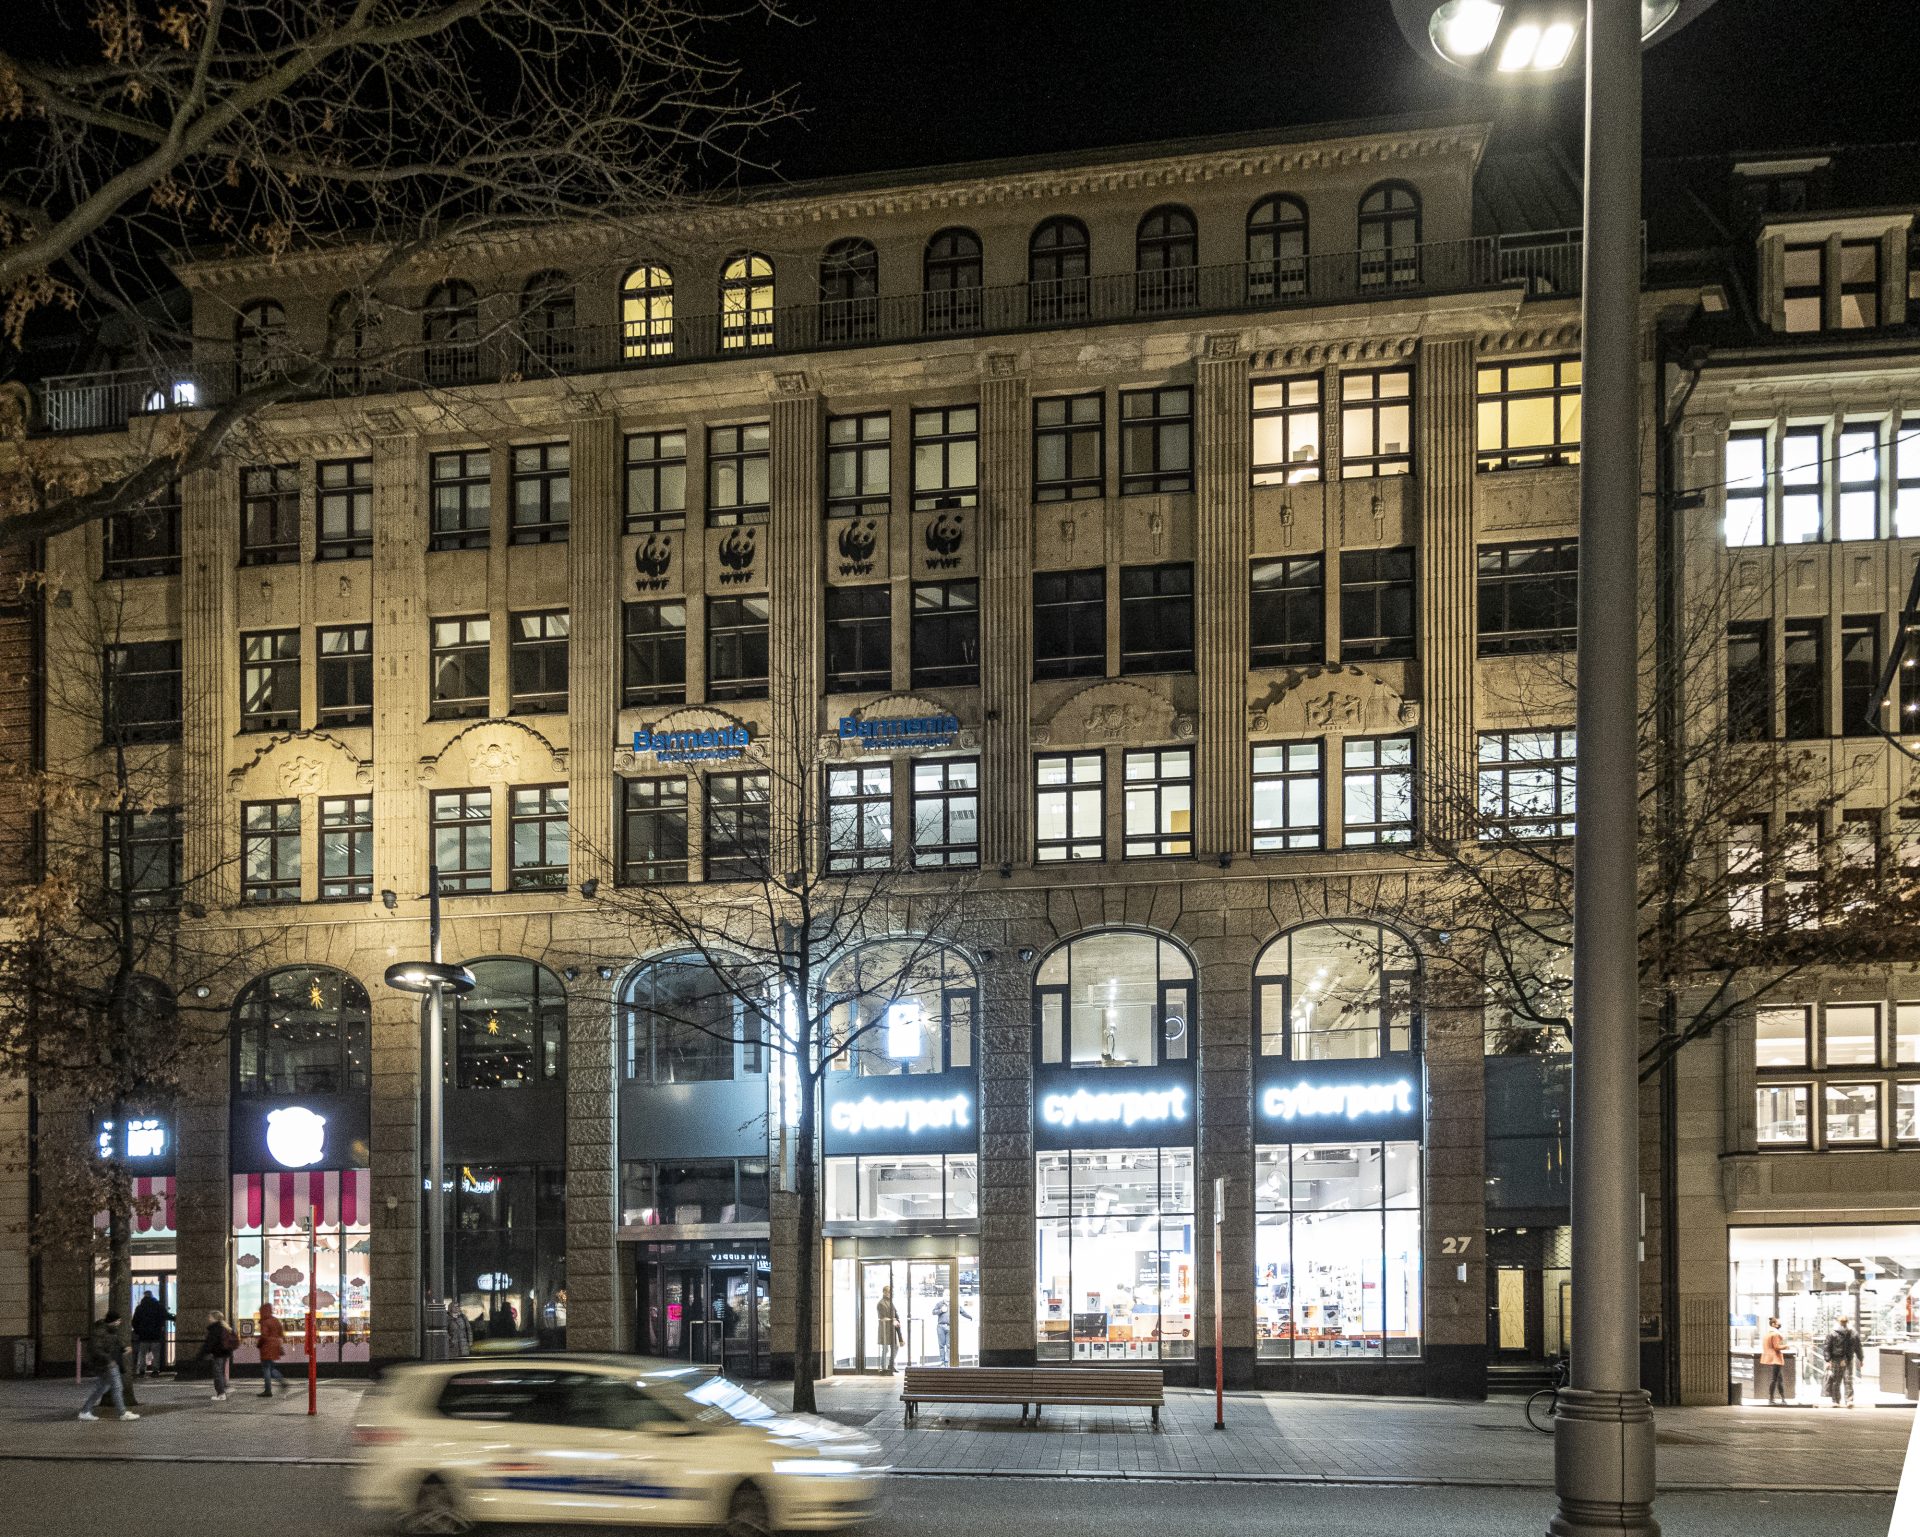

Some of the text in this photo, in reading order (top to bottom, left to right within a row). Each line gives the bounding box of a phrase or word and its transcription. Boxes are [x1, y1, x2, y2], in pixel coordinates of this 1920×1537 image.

[838, 563, 874, 577] WWF
[925, 558, 961, 570] WWF
[635, 577, 670, 591] WWF
[719, 570, 755, 585] WWF
[839, 714, 959, 740] Barmenia
[633, 725, 749, 753] Barmenia
[1043, 1087, 1186, 1127] cyberport
[1264, 1080, 1412, 1120] cyberport
[831, 1094, 969, 1135] cyberport
[1441, 1236, 1472, 1254] 27
